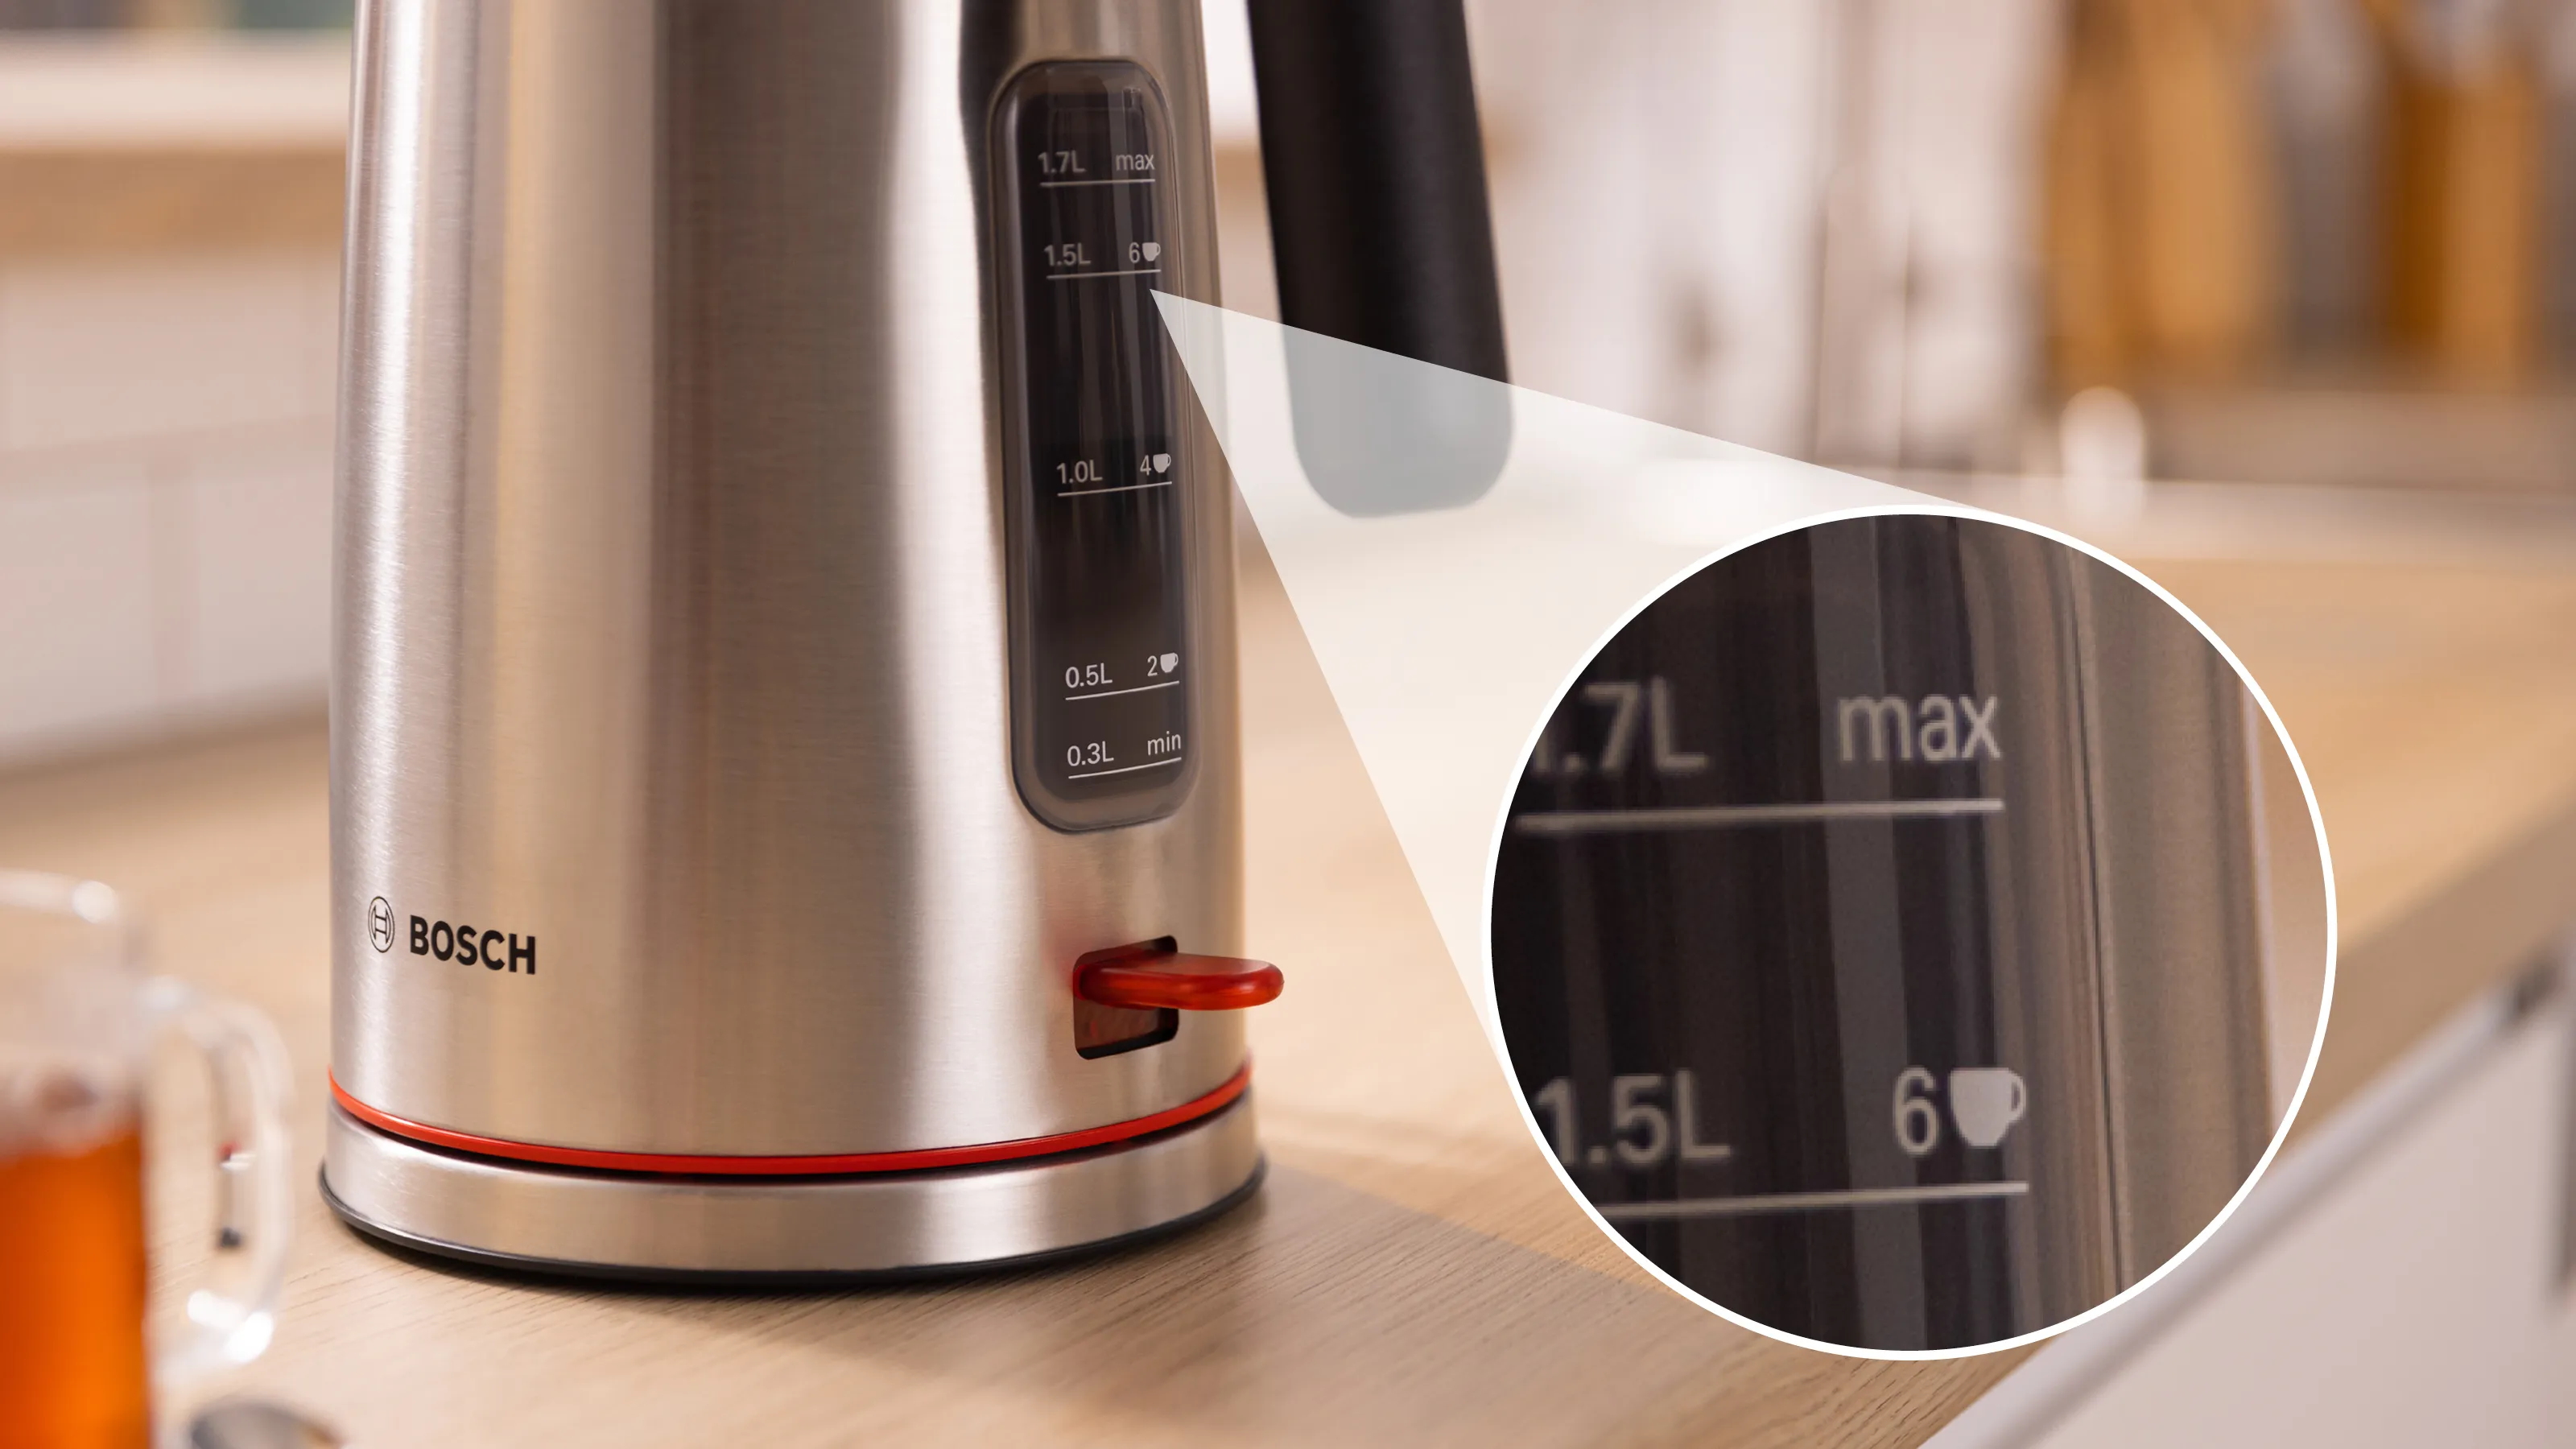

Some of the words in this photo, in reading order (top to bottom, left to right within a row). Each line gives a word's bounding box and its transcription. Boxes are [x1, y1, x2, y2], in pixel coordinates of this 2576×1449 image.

[1038, 150, 1086, 174] 1.7L
[1116, 153, 1155, 171] max
[1043, 242, 1092, 266] 1.5L
[1129, 242, 1141, 264] 6
[1056, 460, 1103, 484] 1.0L
[1139, 455, 1152, 476] 4
[1065, 663, 1113, 688] 0.5L
[1147, 655, 1158, 676] 2
[1838, 694, 2002, 762] max
[1067, 741, 1114, 766] 0.3L
[1147, 731, 1181, 755] min
[410, 914, 535, 975] BOSCH
[1536, 1069, 1731, 1167] 1.5L
[1893, 1067, 1939, 1155] 6
